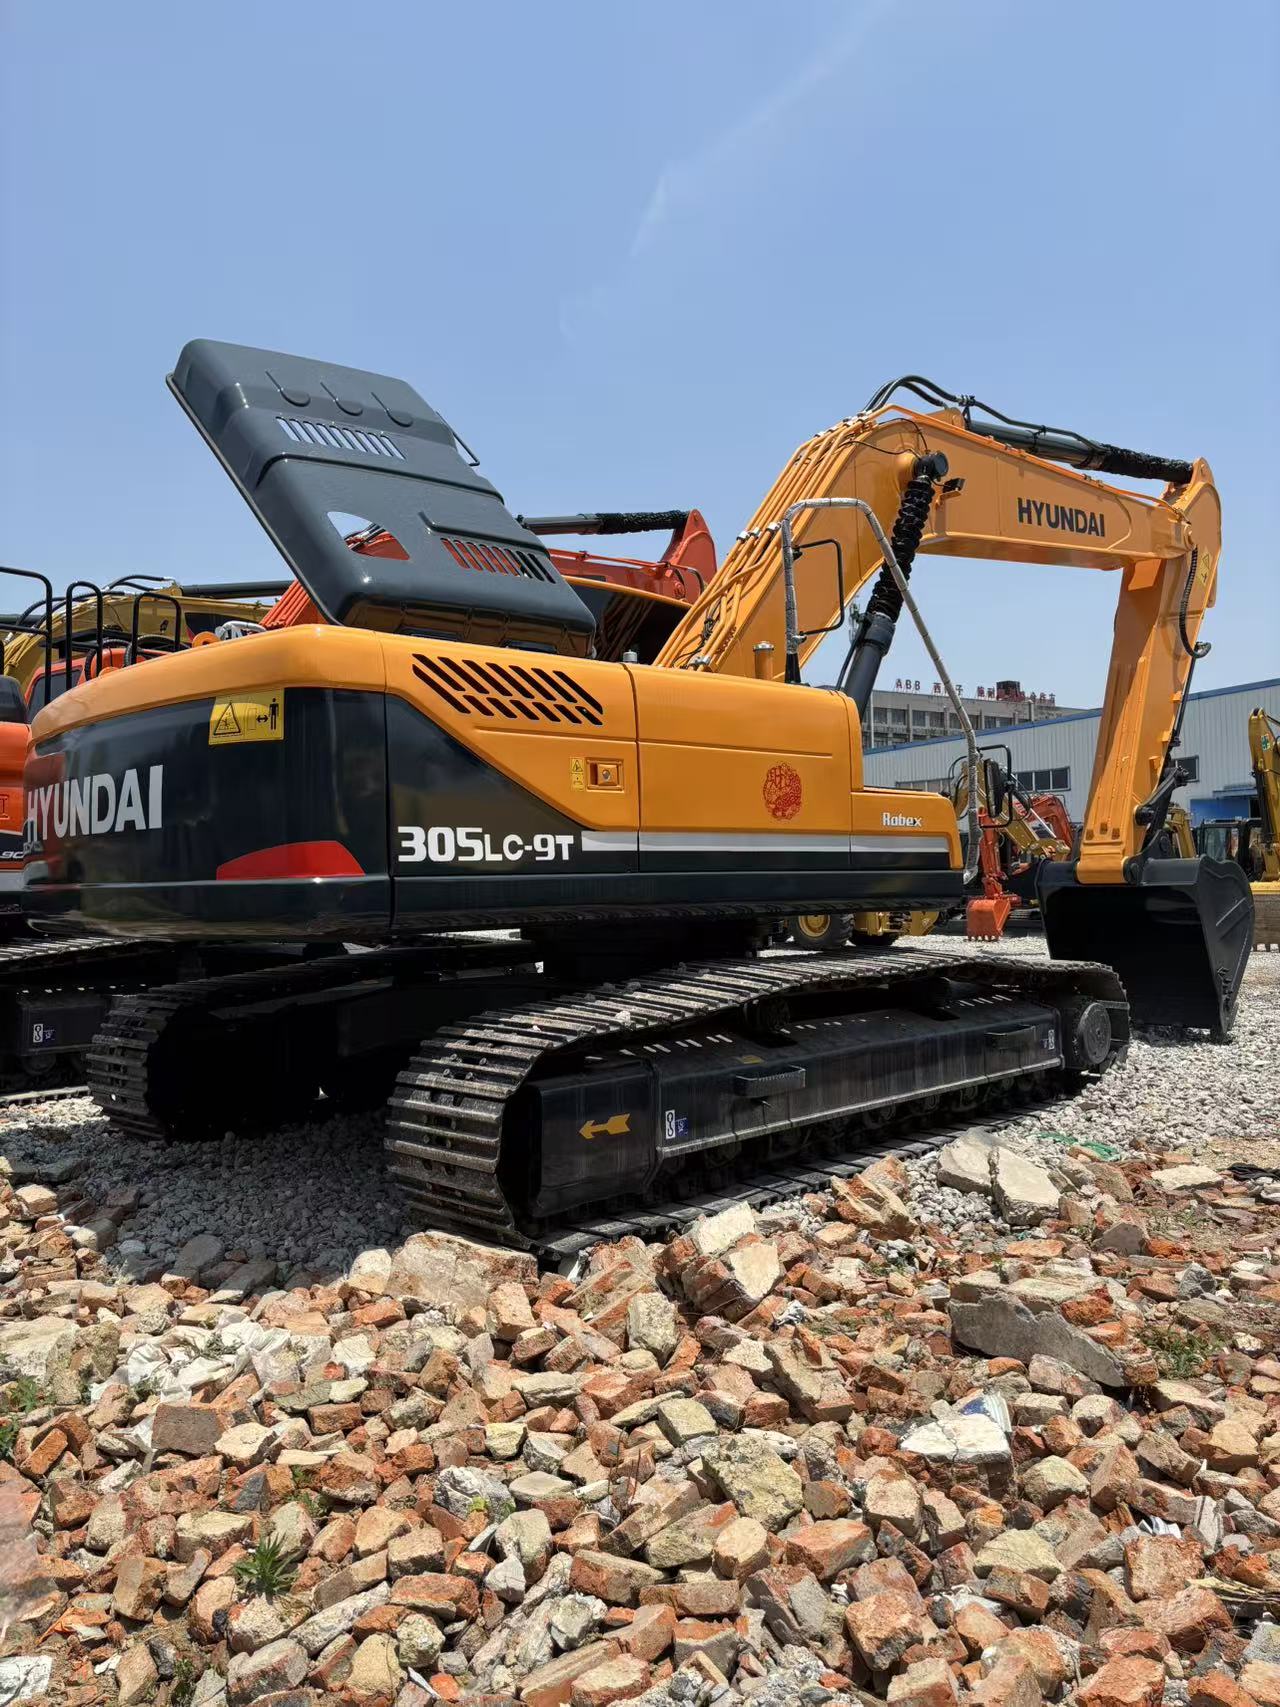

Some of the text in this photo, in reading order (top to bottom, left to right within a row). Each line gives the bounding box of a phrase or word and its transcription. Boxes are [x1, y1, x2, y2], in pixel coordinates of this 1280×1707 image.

[1017, 497, 1105, 537] HYUNDAI
[895, 678, 921, 691] ABB
[933, 682, 964, 696] 西子
[27, 764, 164, 843] HYUNDAI
[397, 826, 574, 862] 305LC-9T
